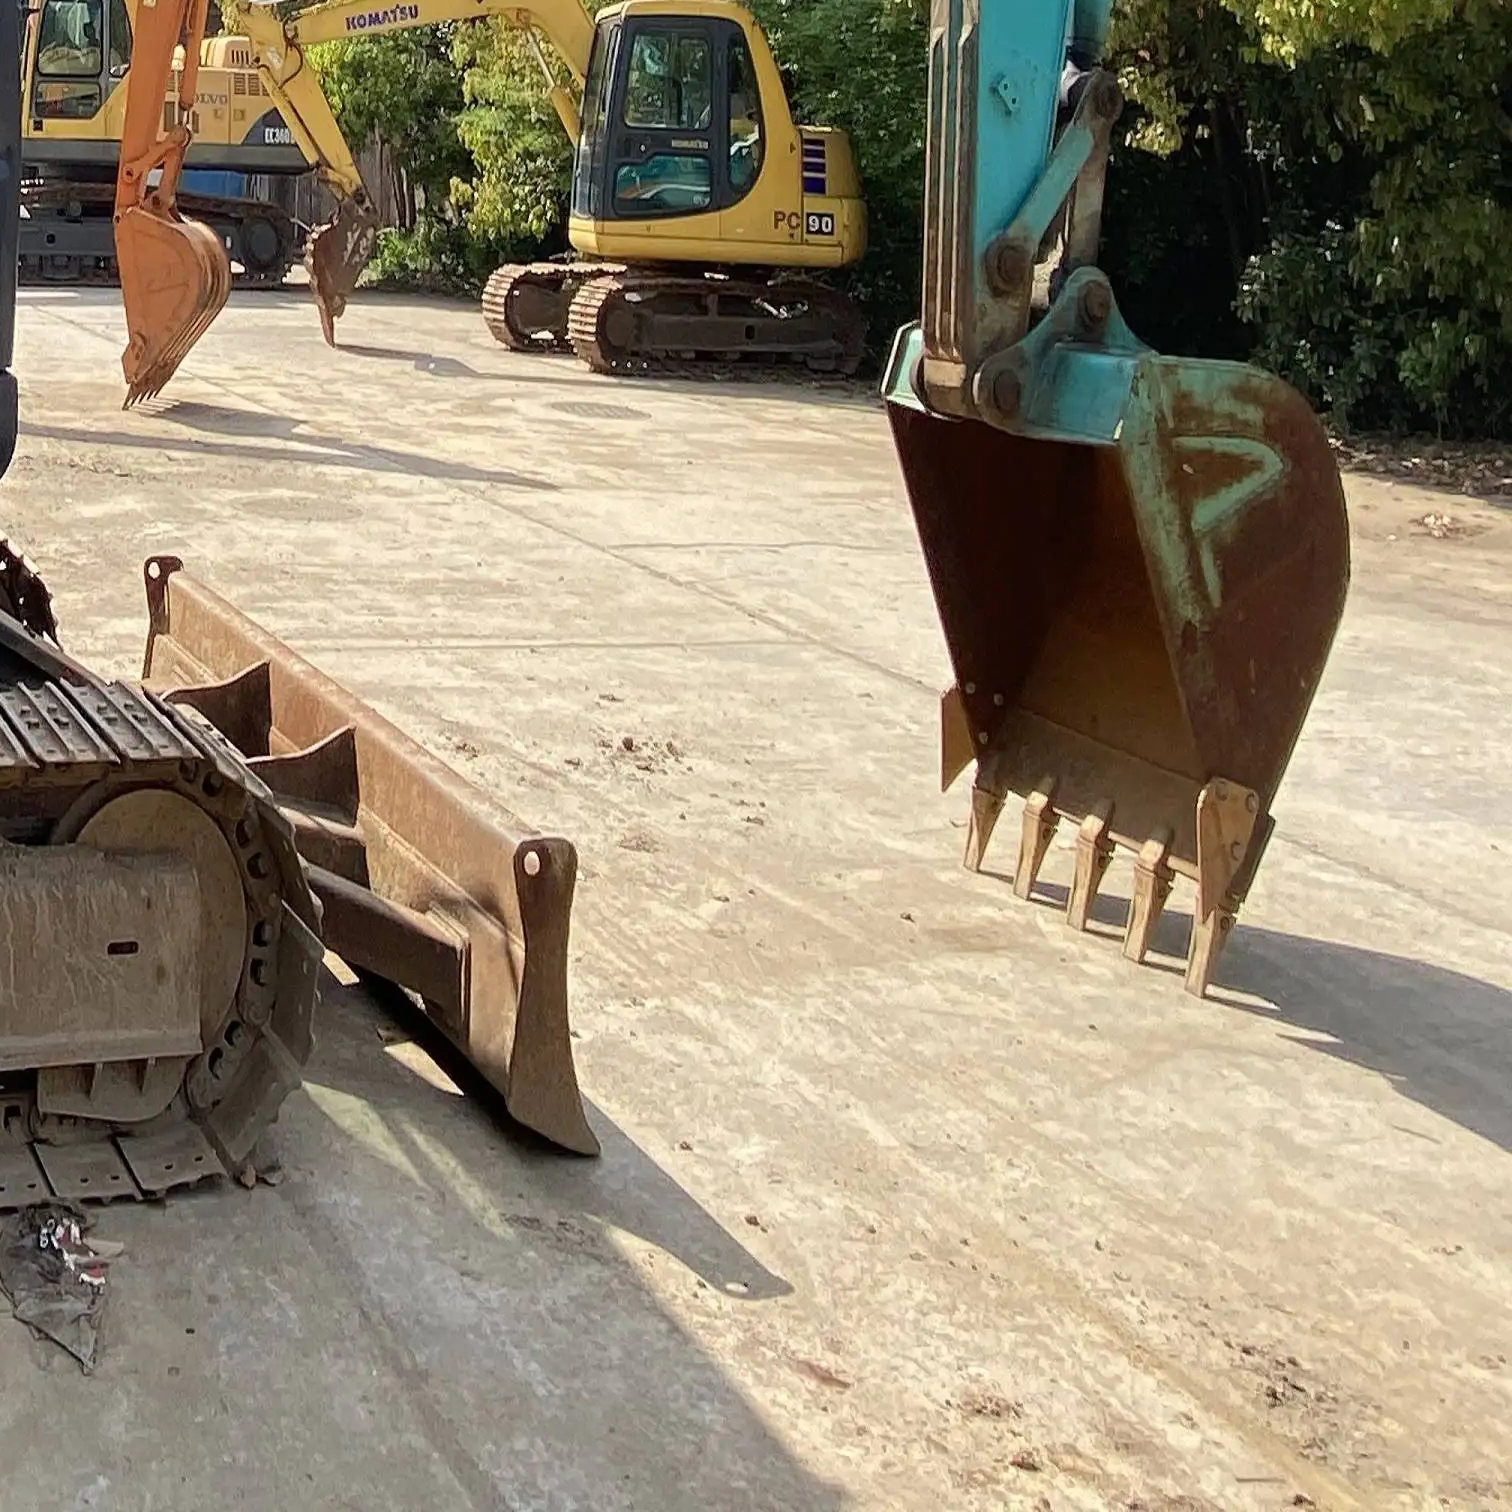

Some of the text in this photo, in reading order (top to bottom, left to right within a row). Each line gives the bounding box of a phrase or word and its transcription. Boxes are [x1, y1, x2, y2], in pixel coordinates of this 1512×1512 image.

[345, 3, 419, 31] KOMATSU
[773, 211, 832, 233] PC 90
